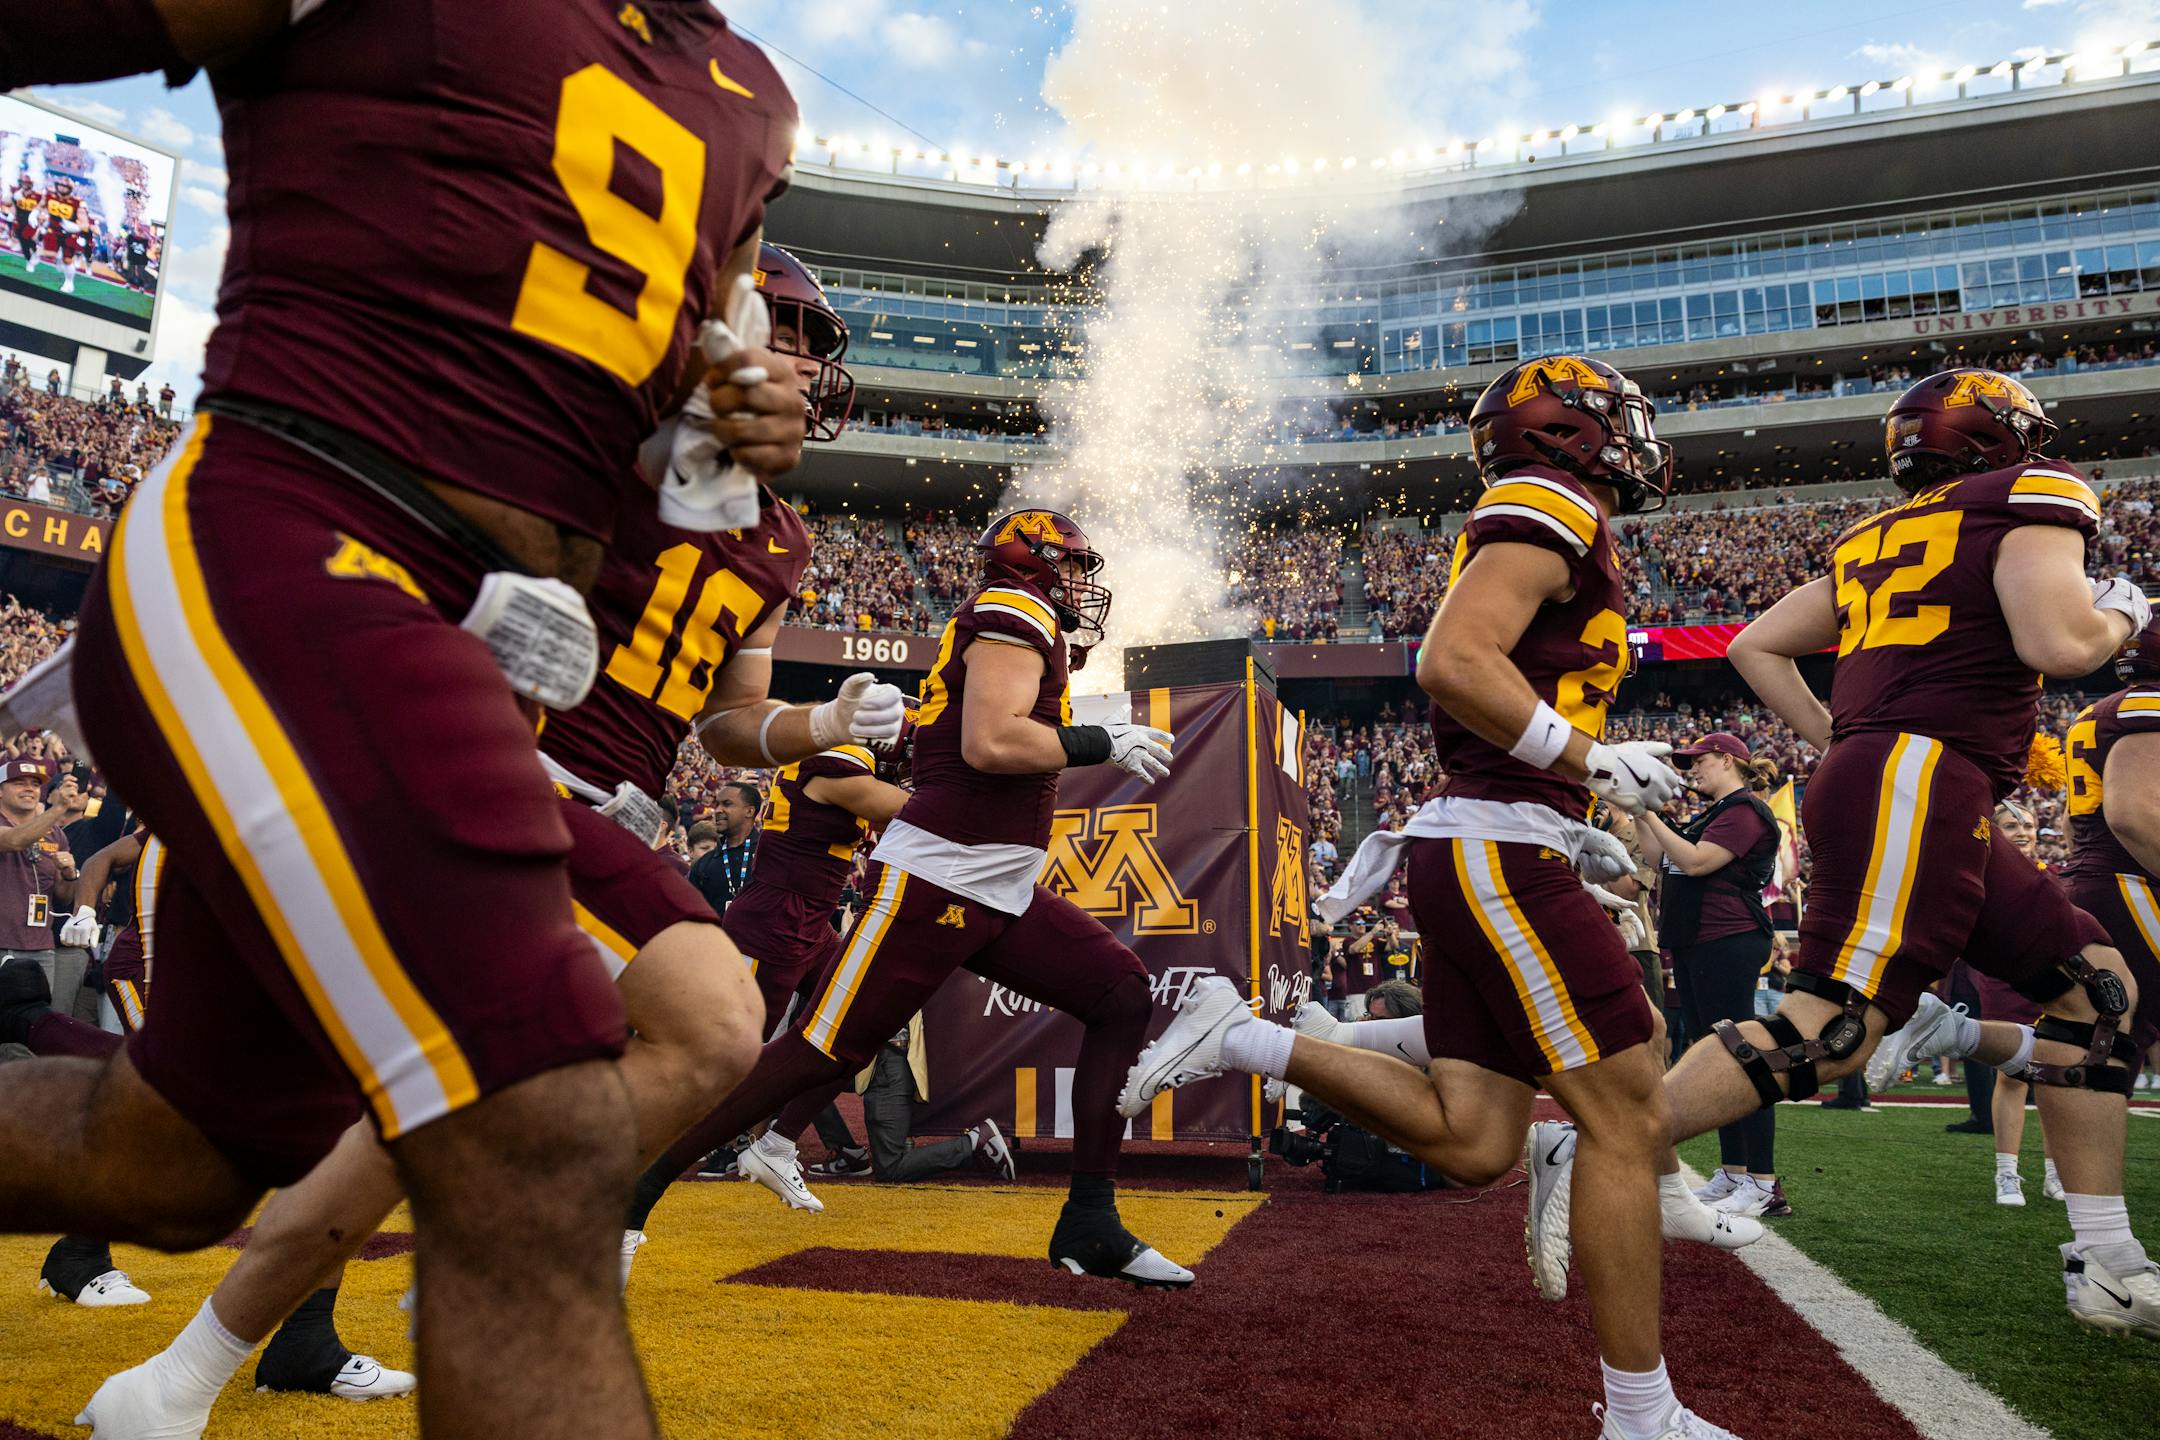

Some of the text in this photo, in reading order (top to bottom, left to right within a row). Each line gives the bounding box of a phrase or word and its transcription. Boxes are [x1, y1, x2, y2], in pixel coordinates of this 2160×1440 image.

[511, 62, 706, 388] 9
[1914, 298, 2134, 334] UNIVERSITY
[994, 511, 1064, 546] M
[604, 542, 766, 722] 16
[841, 636, 909, 663] 1960
[1036, 803, 1199, 935] M
